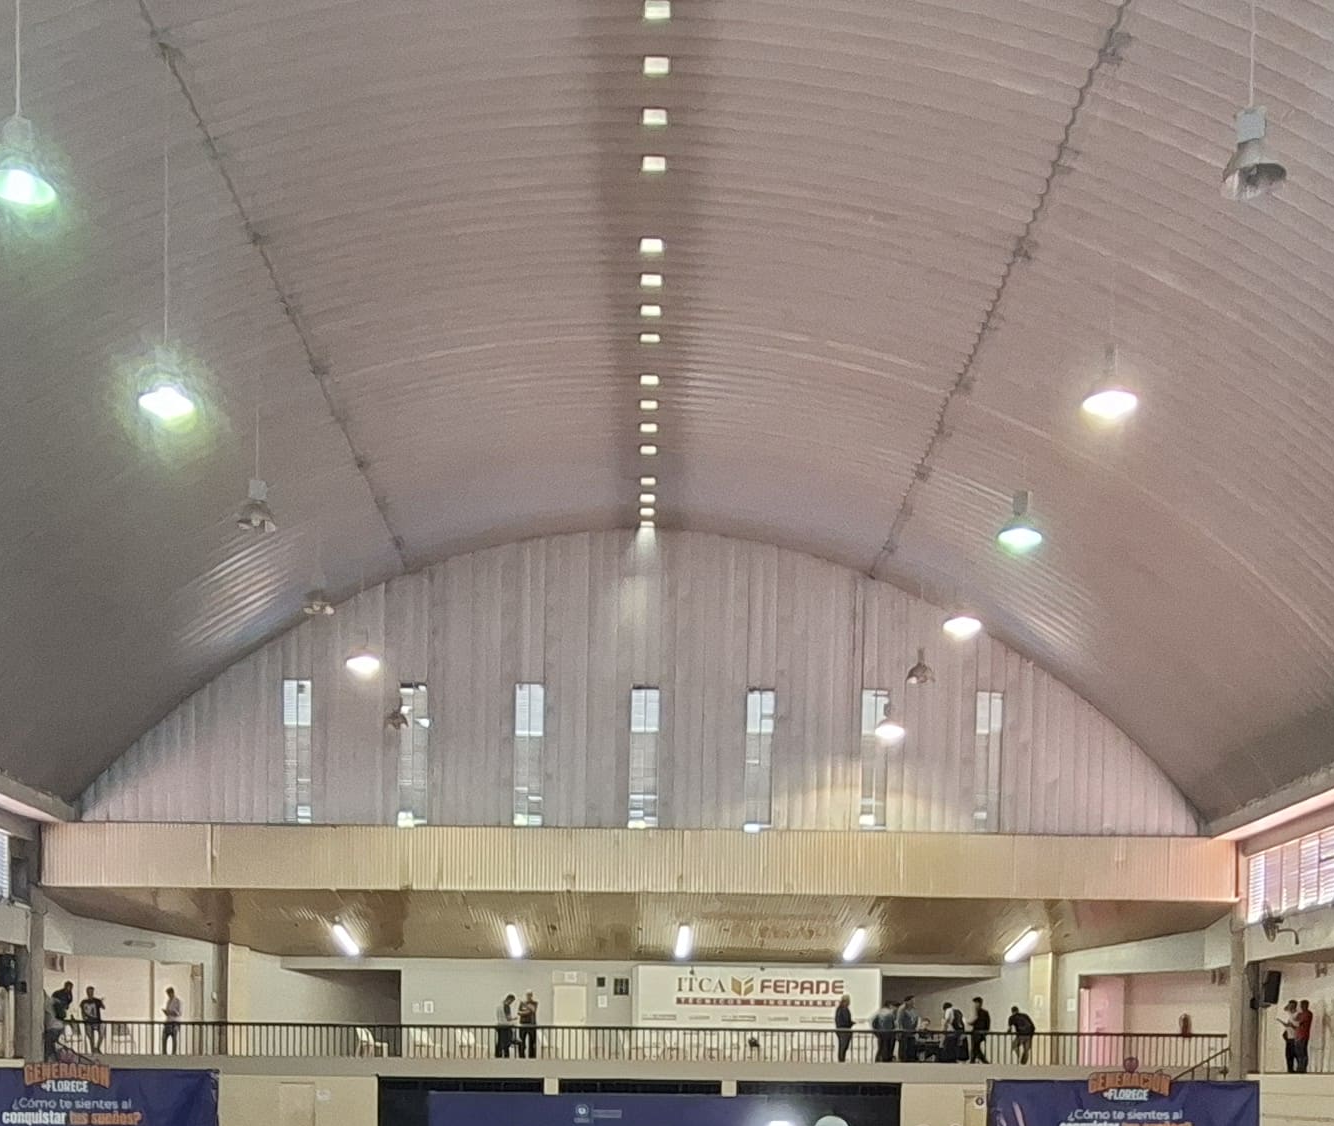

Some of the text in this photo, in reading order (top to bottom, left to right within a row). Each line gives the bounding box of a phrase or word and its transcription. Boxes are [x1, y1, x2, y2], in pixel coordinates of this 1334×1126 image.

[677, 977, 844, 994] ITCA FEPADE
[12, 1097, 132, 1110] ¿Cómo te sientes al
[2, 1109, 67, 1126] conquistar
[1068, 1109, 1183, 1121] ¿Cómo te sientes al
